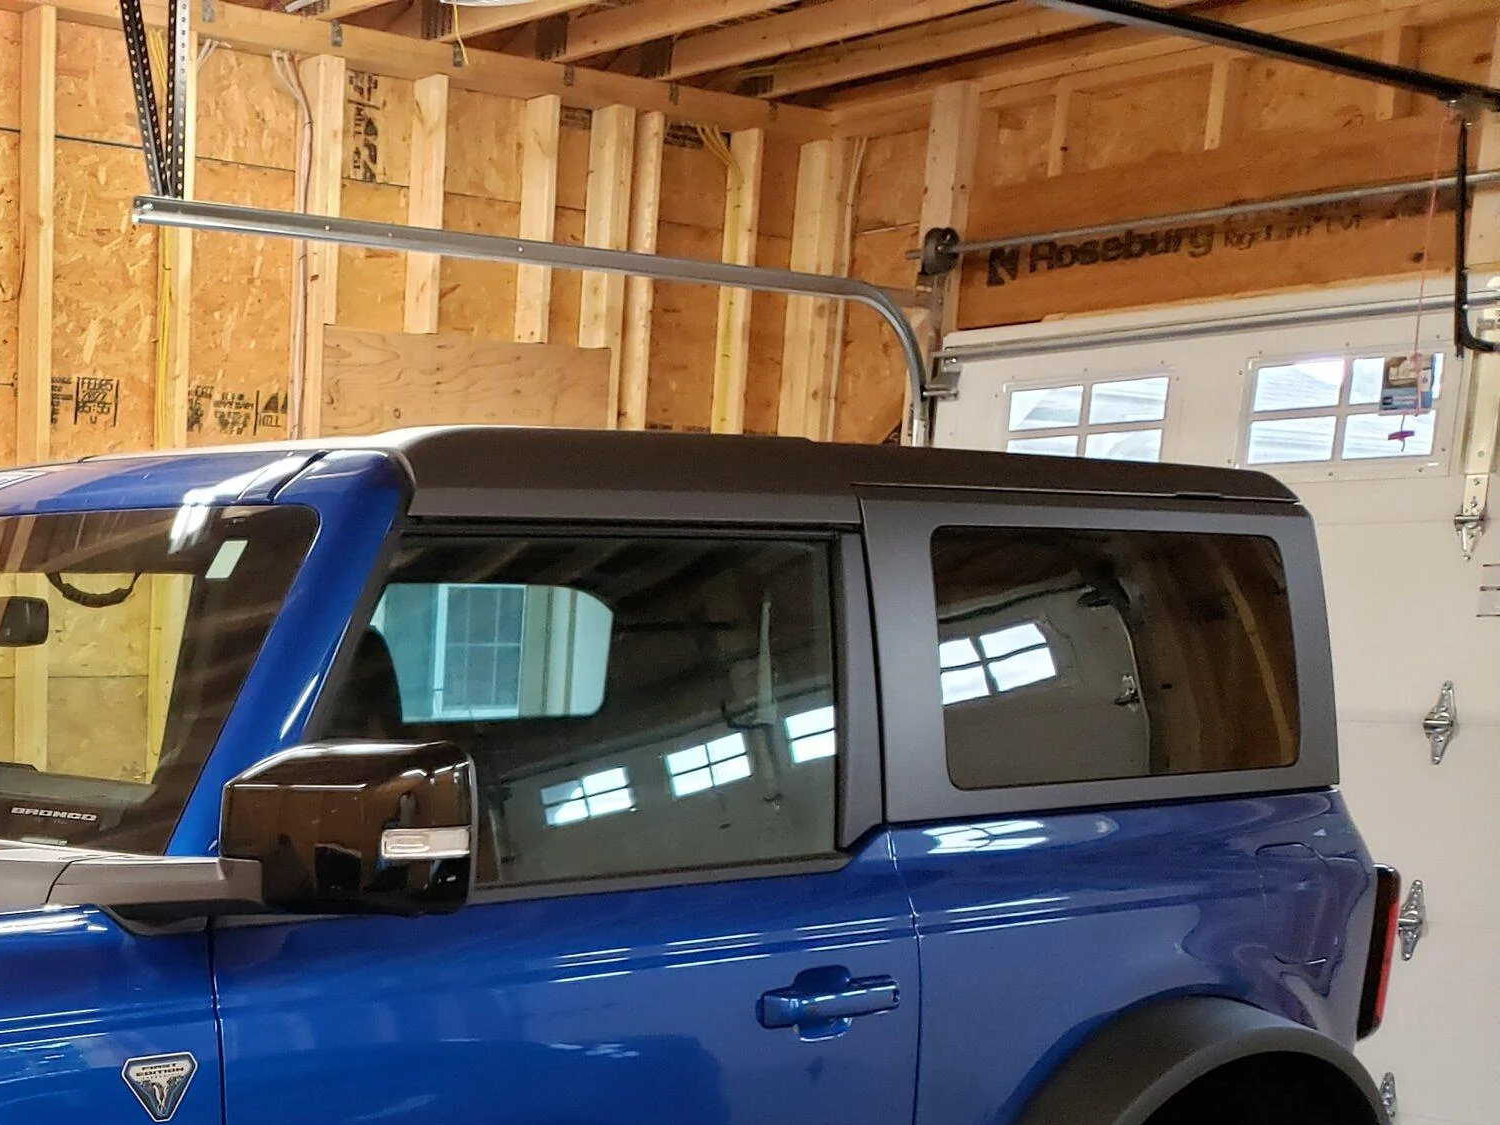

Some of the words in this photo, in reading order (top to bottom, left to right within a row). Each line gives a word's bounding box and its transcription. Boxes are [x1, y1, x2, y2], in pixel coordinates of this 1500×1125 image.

[1029, 223, 1216, 274] Roseburg
[11, 806, 98, 821] BRONCO
[135, 1067, 185, 1077] EDITION
[141, 1062, 178, 1071] FIRST
